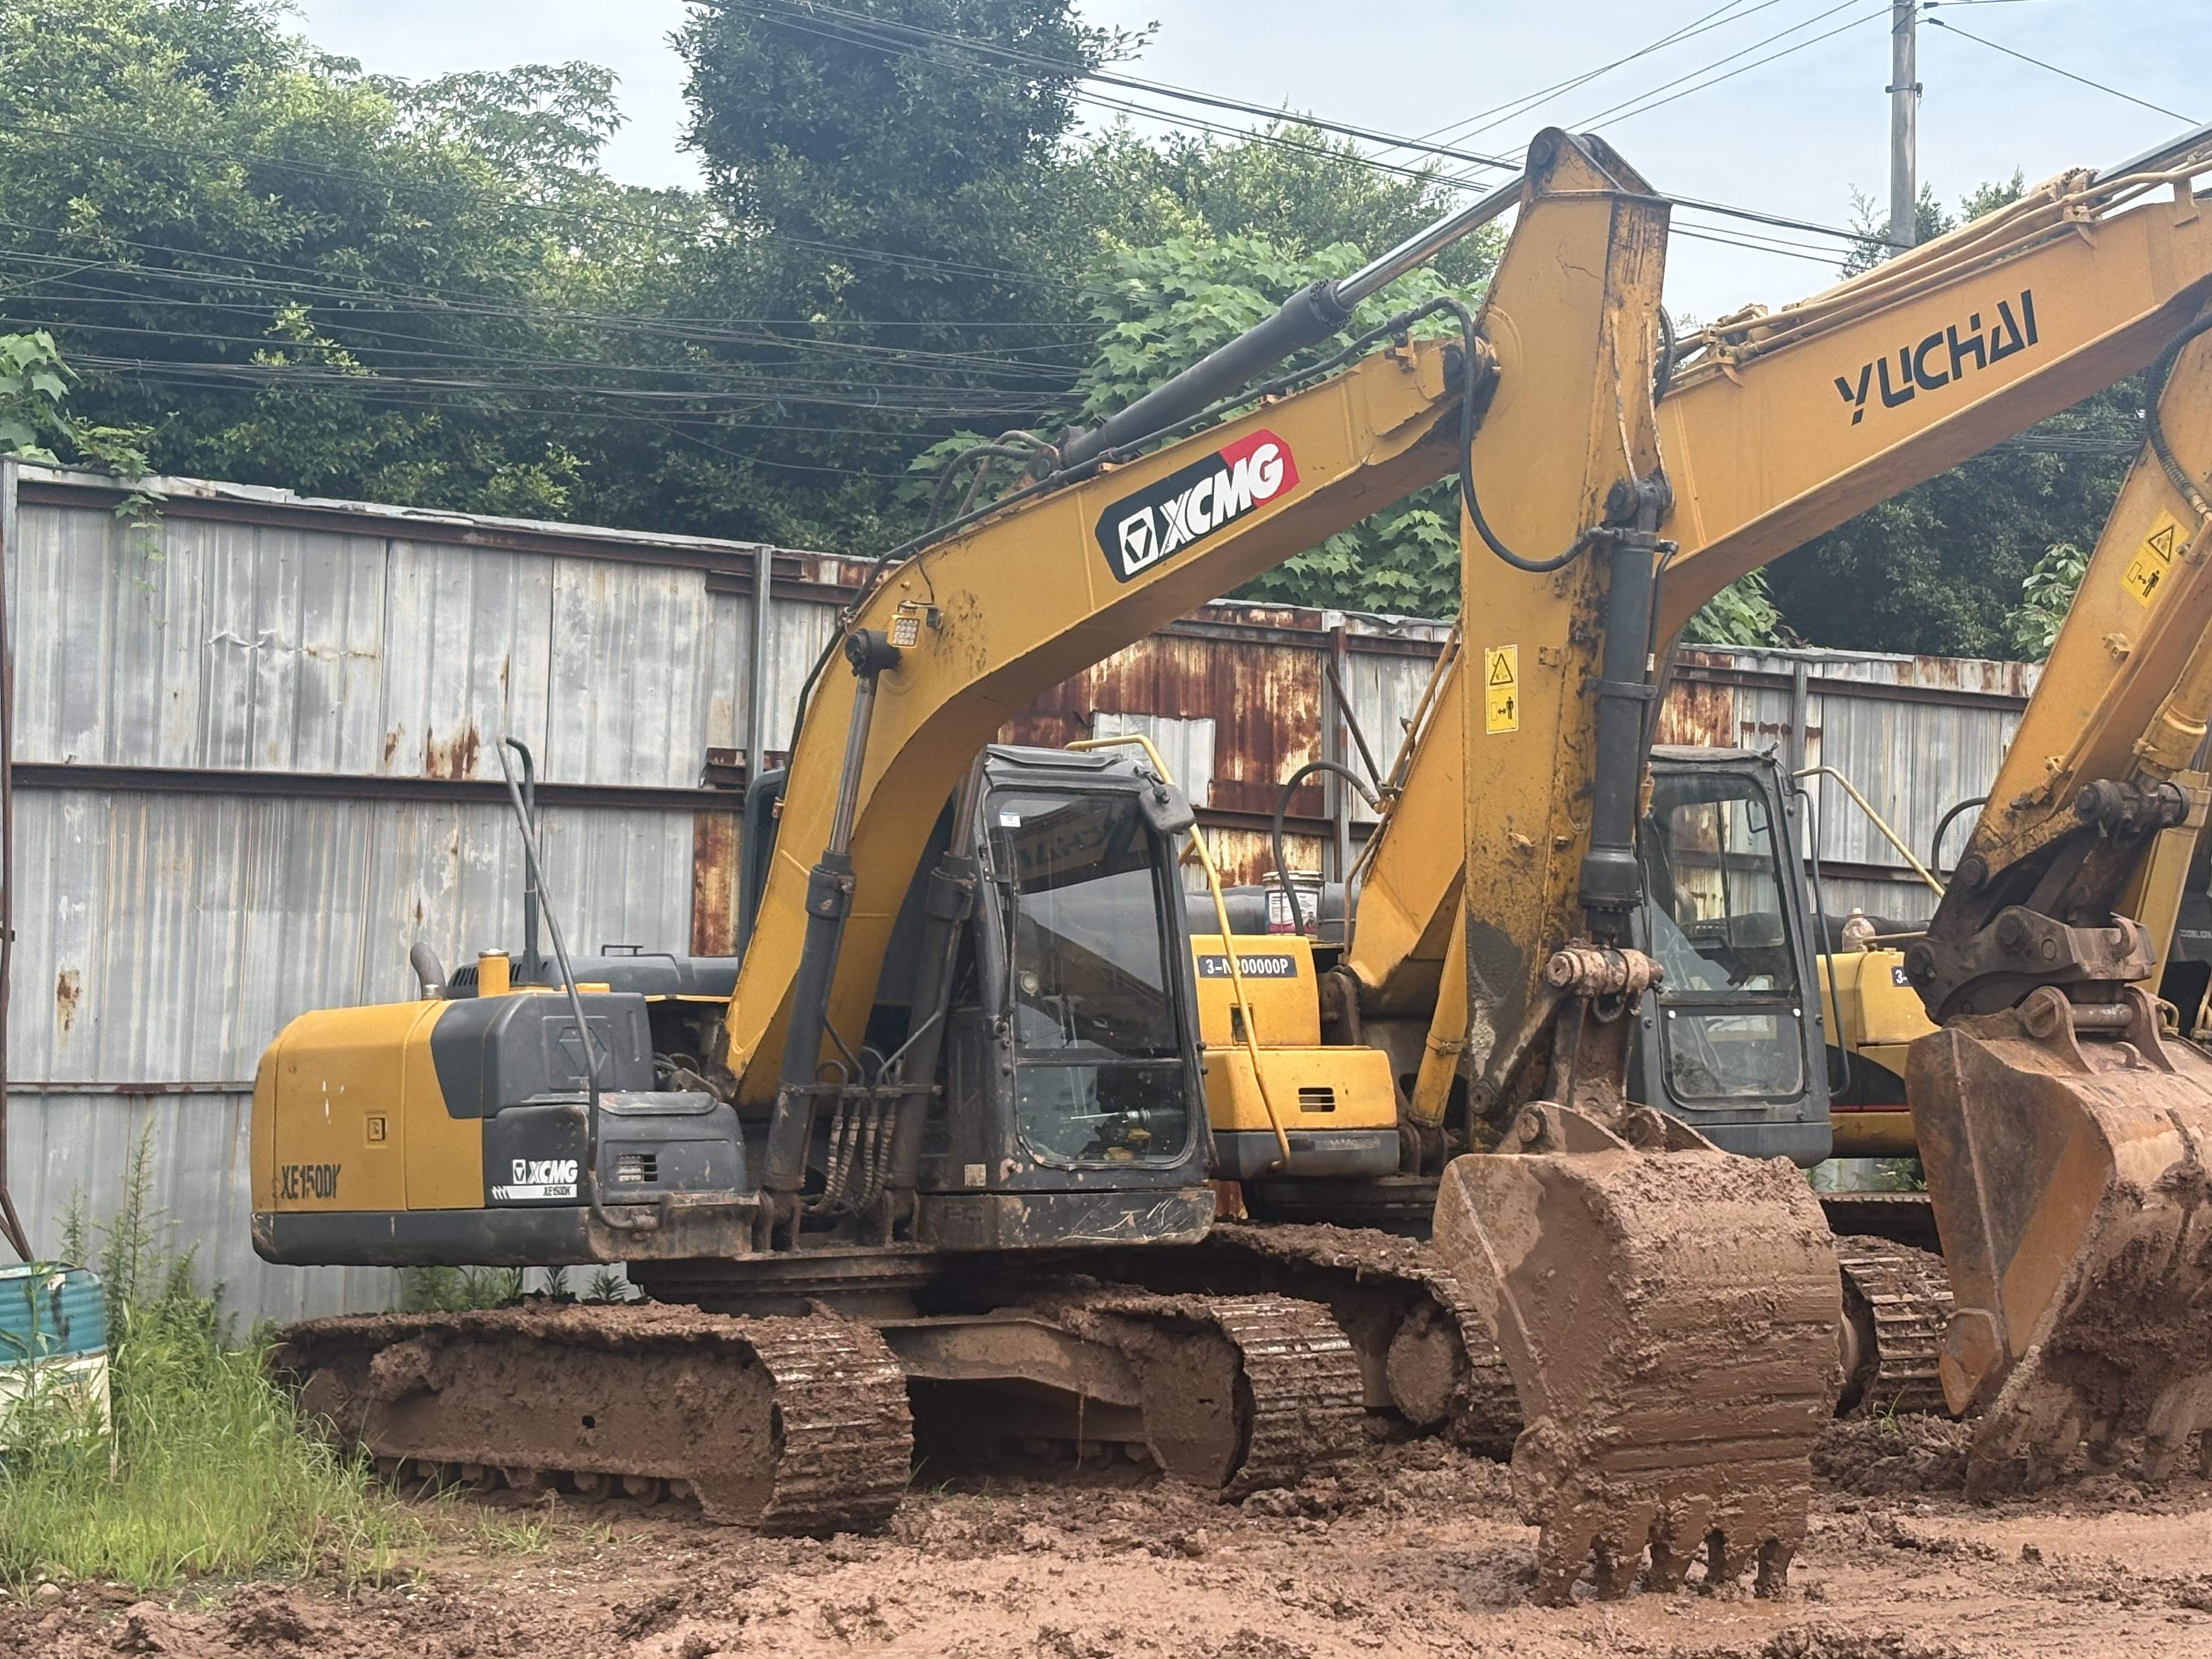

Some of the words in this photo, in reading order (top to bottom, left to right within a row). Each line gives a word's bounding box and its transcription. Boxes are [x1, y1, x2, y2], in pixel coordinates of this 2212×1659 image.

[1833, 289, 2038, 426] YUCHAI
[1159, 443, 1284, 557] XCMG
[527, 1159, 578, 1184] XCMG
